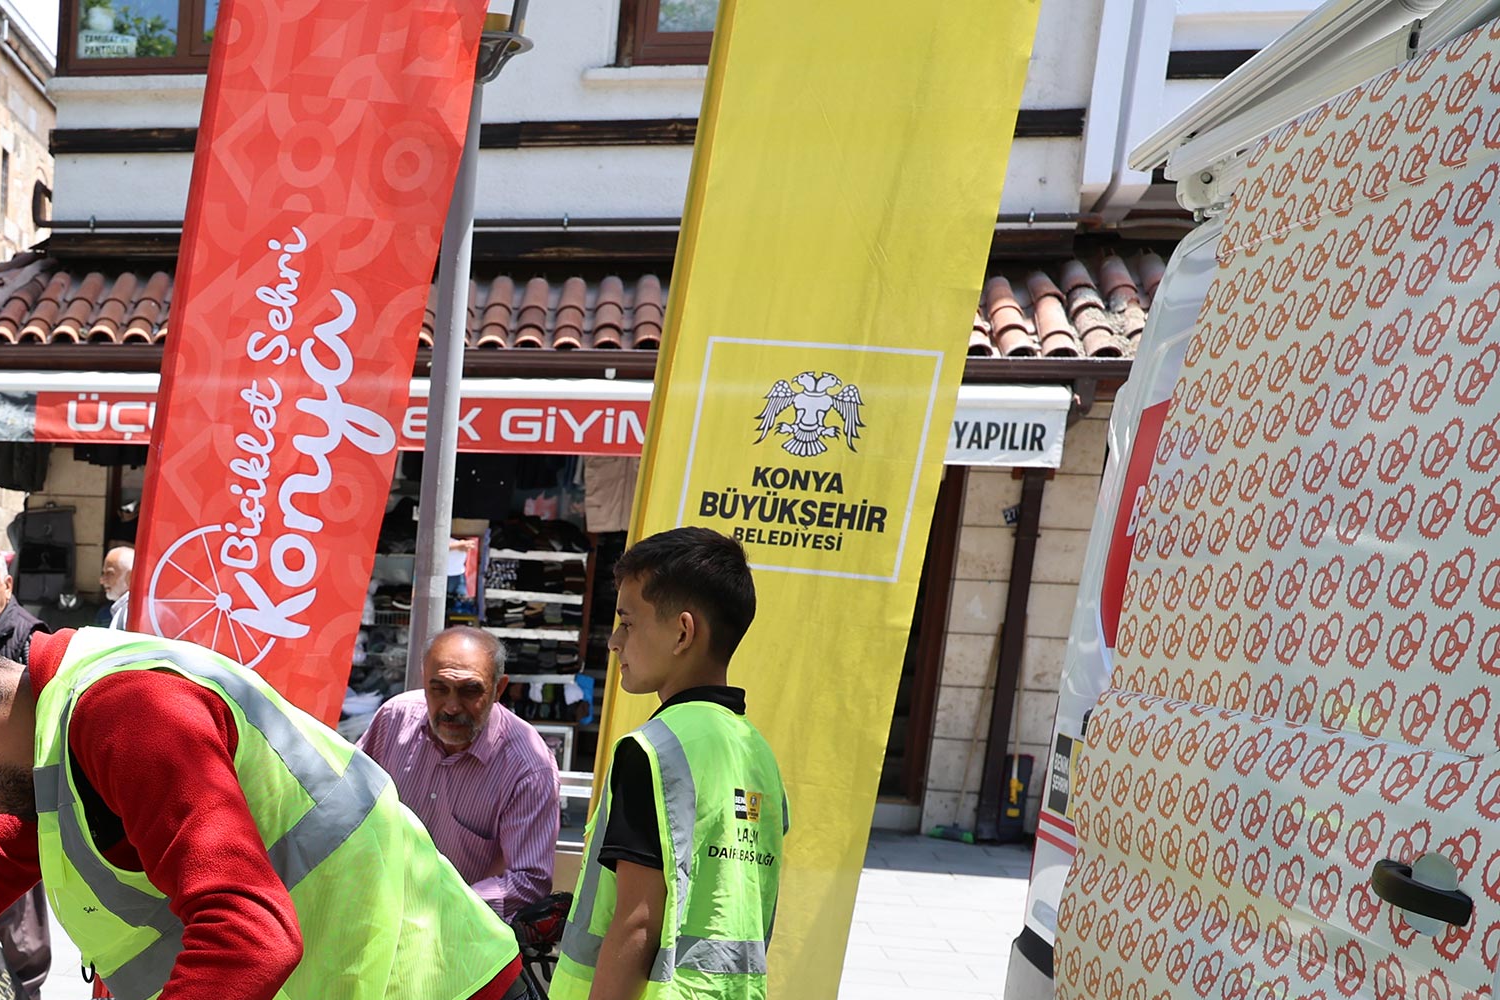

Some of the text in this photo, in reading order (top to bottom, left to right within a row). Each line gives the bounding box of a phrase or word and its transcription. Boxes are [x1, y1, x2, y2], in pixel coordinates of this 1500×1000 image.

[220, 226, 307, 569] Bisiklet Şehri
[953, 421, 1047, 451] YAPILIR
[229, 288, 397, 639] Konya
[751, 466, 844, 494] KONYA
[699, 487, 888, 533] BÜYÜKŞEHİR
[733, 527, 844, 552] BELEDİYESİ
